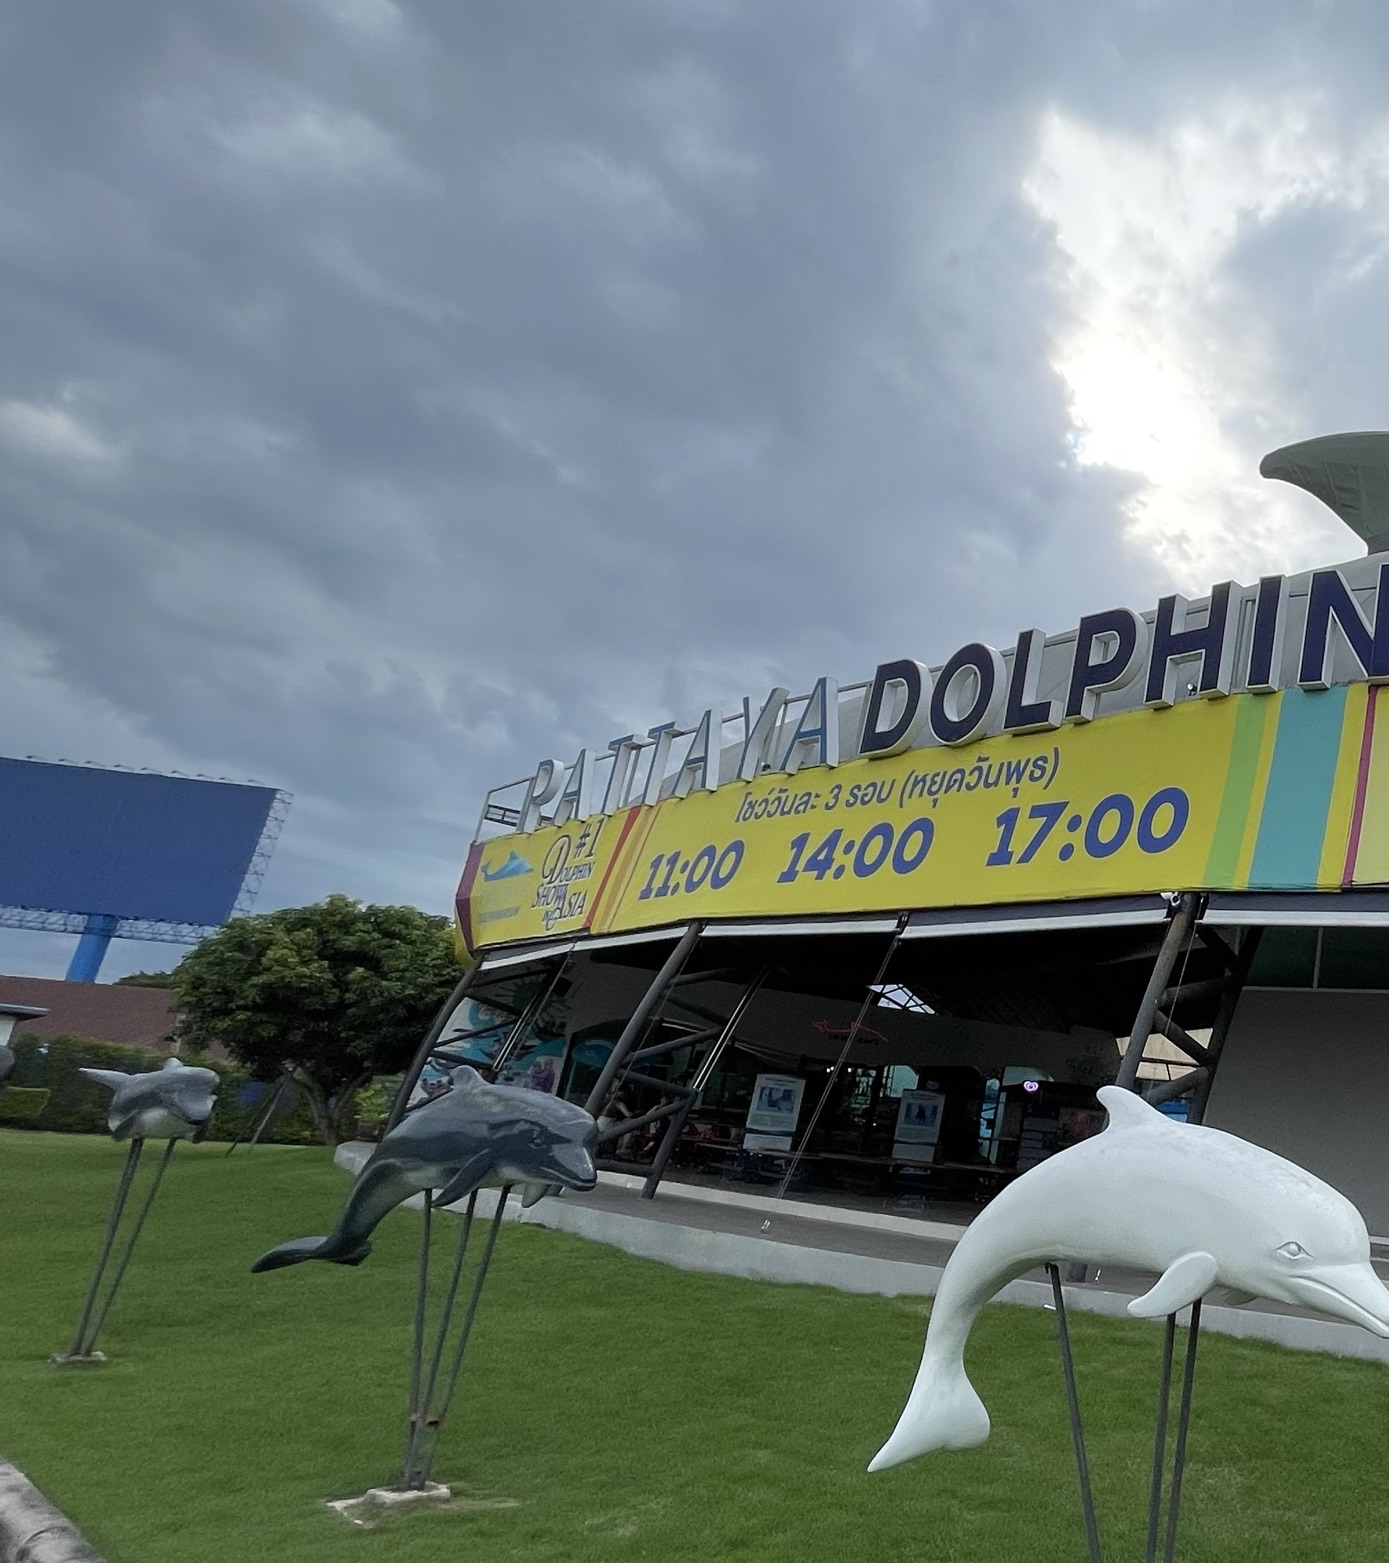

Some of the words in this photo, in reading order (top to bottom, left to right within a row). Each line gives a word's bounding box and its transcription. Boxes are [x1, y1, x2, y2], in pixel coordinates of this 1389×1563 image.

[516, 676, 839, 834] PATTAYA
[735, 785, 822, 823] โชว์วันละ
[824, 784, 842, 811] 3
[844, 777, 897, 809] รอบ
[638, 839, 746, 900] 11:00
[776, 817, 935, 884] 14:00
[985, 786, 1190, 867] 17:00
